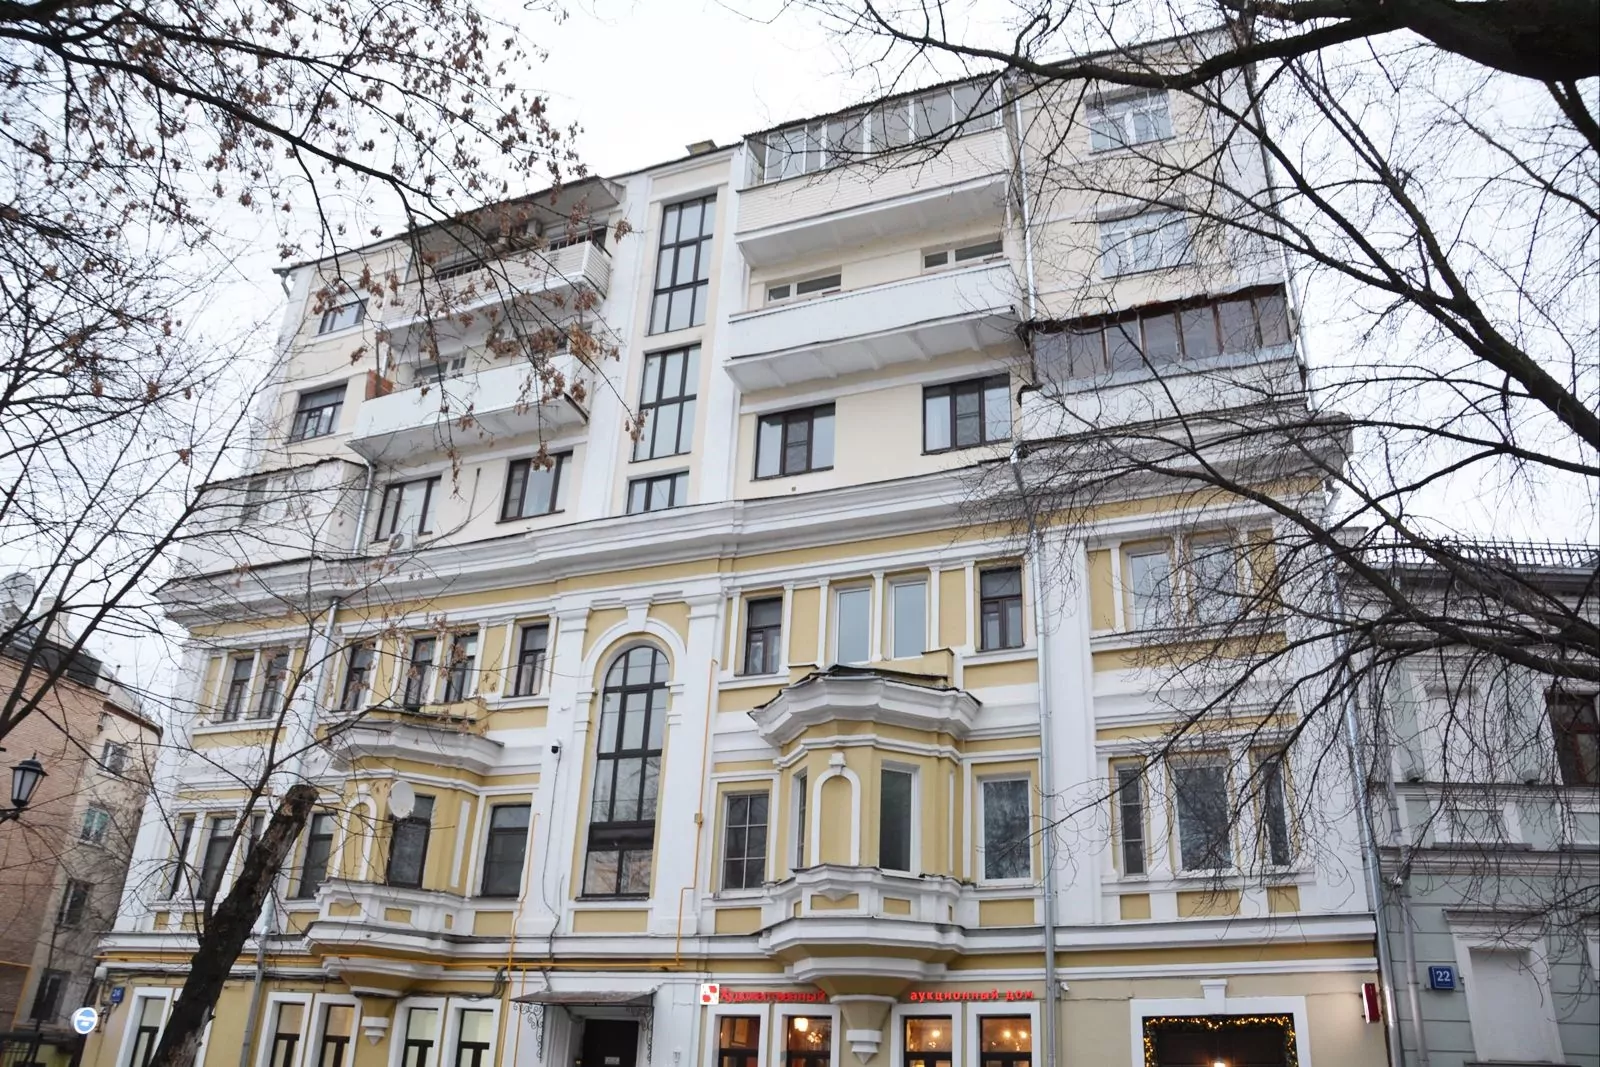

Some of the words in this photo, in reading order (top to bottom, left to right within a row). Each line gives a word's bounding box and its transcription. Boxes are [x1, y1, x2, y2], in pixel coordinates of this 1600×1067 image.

[1436, 970, 1451, 981] 22
[910, 988, 998, 1003] аукционный
[1005, 990, 1034, 1001] дом
